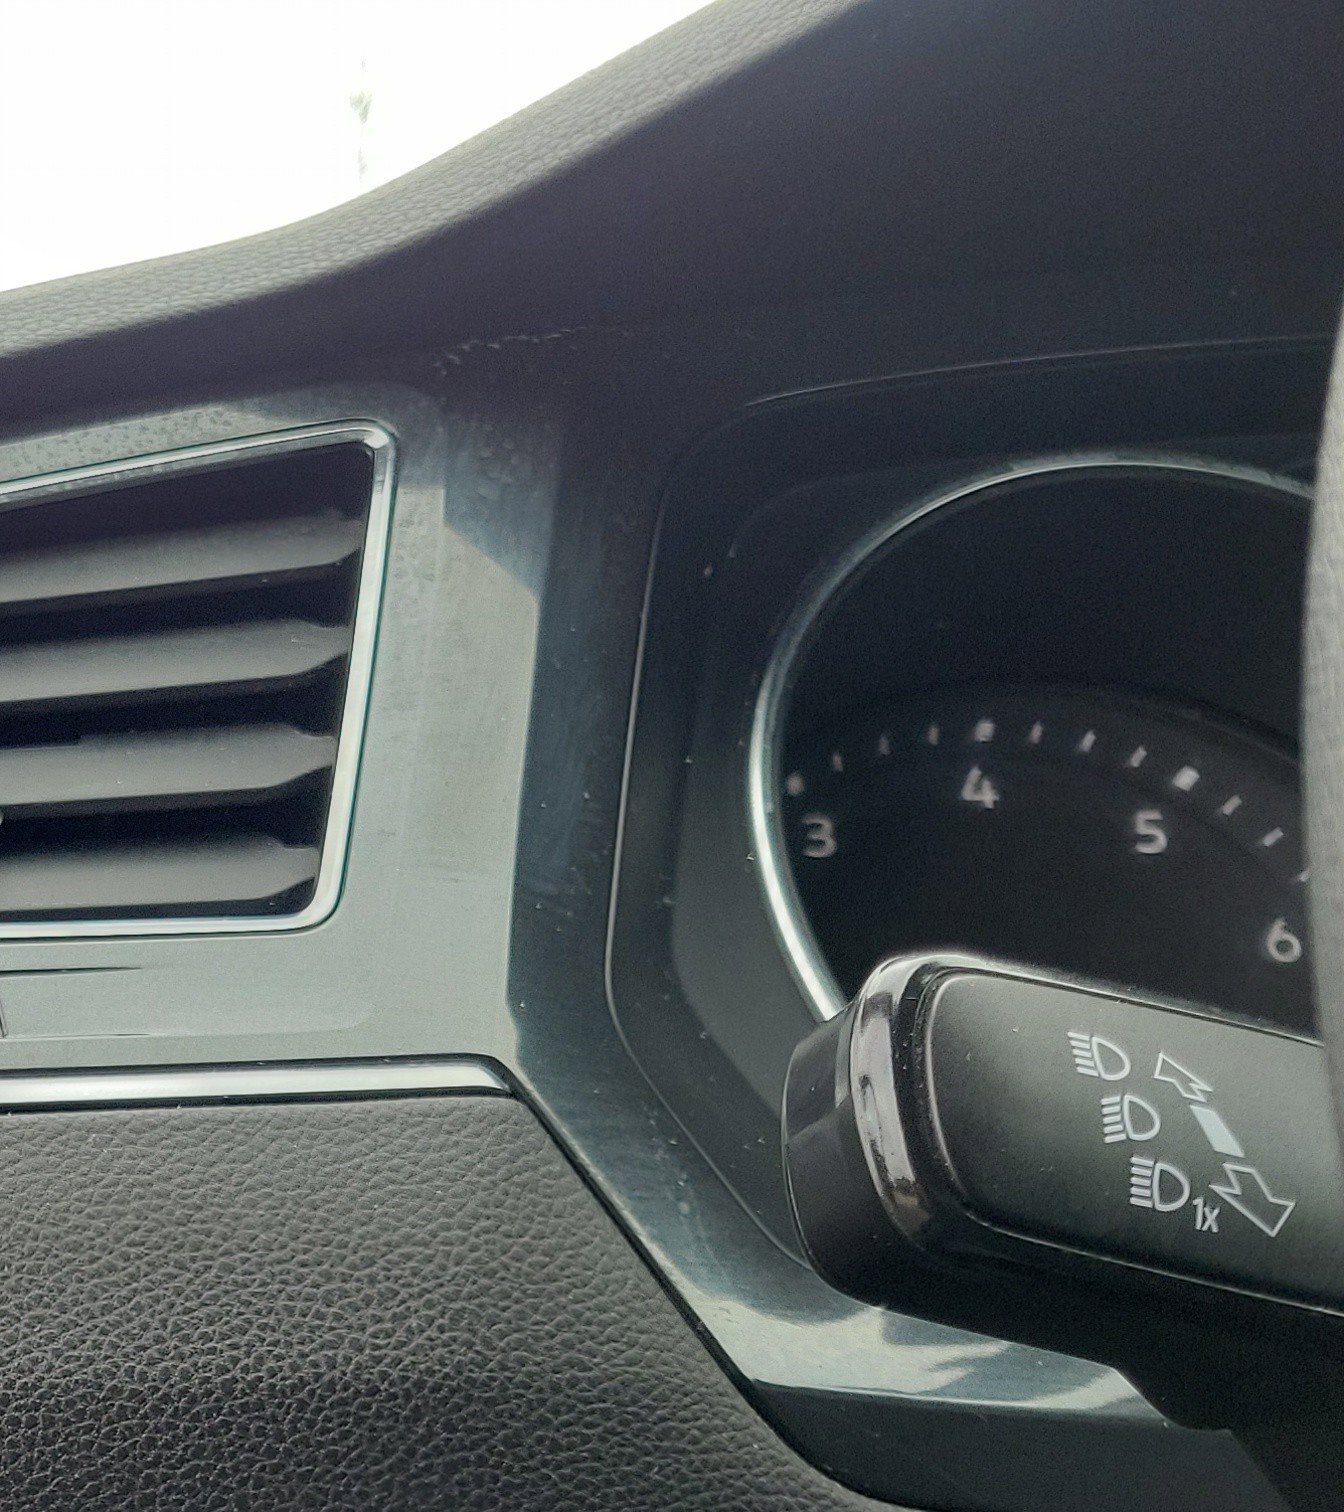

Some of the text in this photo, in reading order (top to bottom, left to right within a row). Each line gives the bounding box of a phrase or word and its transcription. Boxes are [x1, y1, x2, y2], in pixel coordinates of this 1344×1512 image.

[961, 766, 999, 809] 4
[804, 814, 836, 857] 3
[1133, 810, 1167, 854] 5
[1265, 920, 1301, 962] 6
